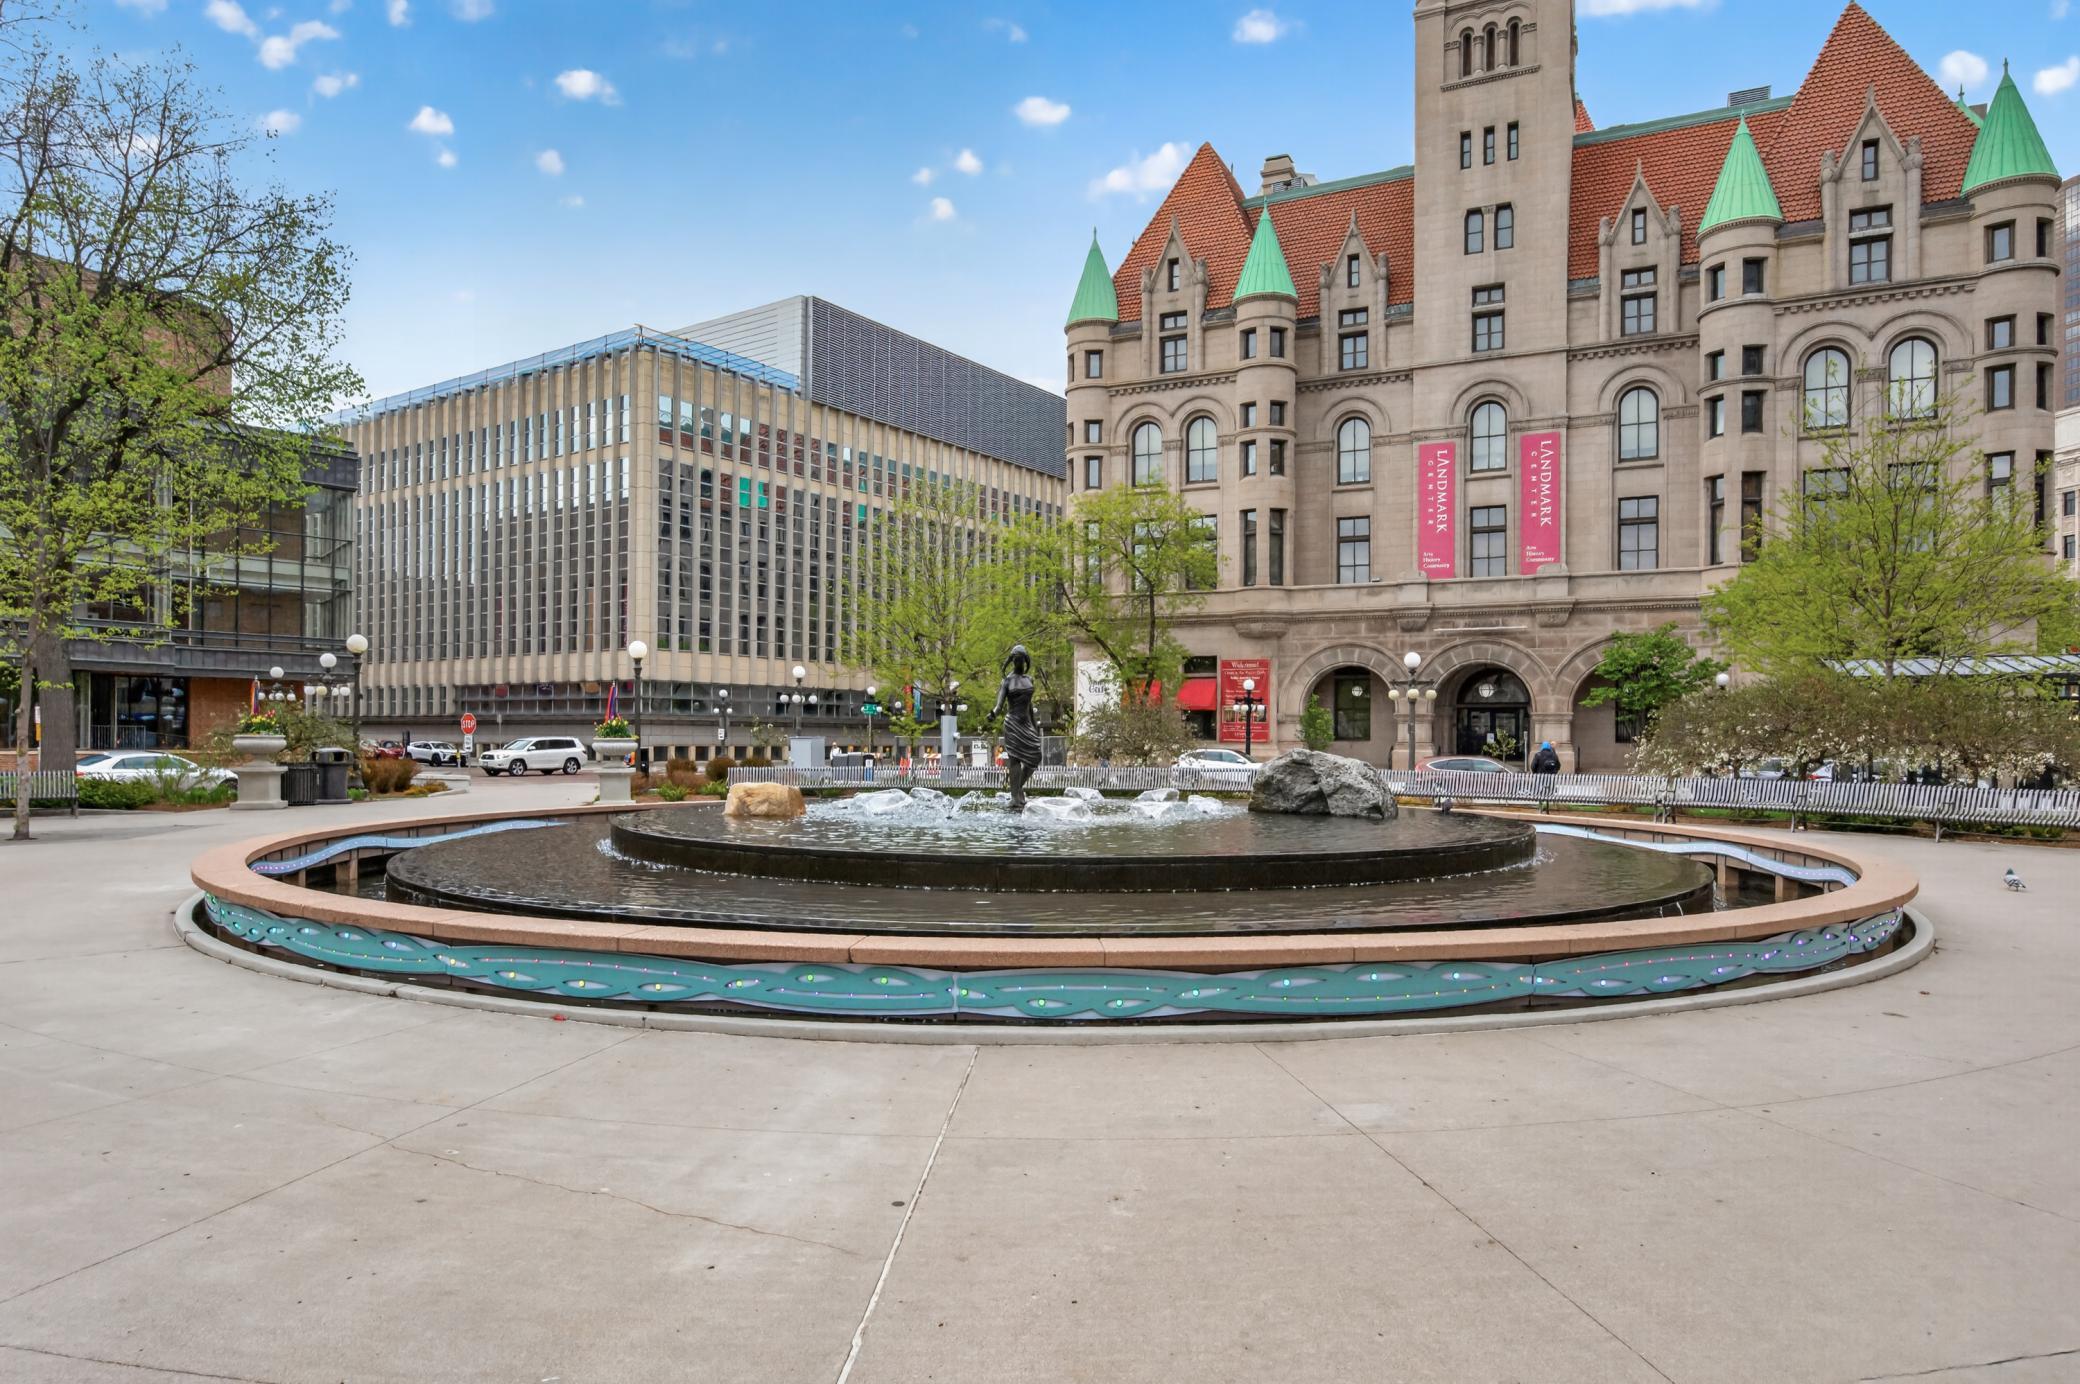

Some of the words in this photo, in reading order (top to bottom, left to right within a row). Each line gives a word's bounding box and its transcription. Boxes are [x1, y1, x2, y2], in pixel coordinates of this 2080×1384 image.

[1436, 449, 1450, 533] LANDMARK
[1540, 440, 1554, 527] LANDMARK
[462, 719, 475, 728] STOP
